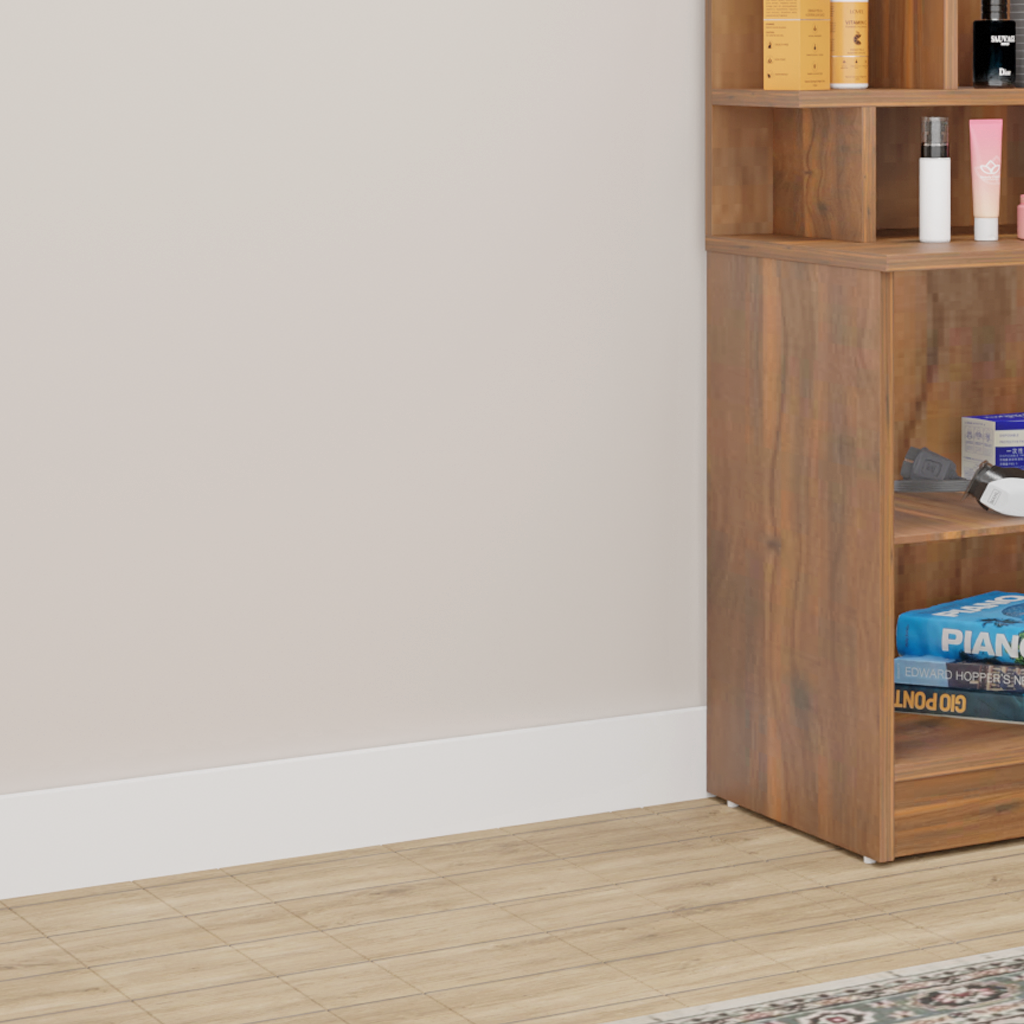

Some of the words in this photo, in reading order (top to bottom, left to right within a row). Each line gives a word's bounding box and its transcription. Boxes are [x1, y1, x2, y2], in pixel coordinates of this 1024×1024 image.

[998, 67, 1012, 76] Dior
[905, 666, 953, 680] EDWARD
[955, 670, 1011, 685] HOPPER'S
[939, 692, 967, 714] GIO
